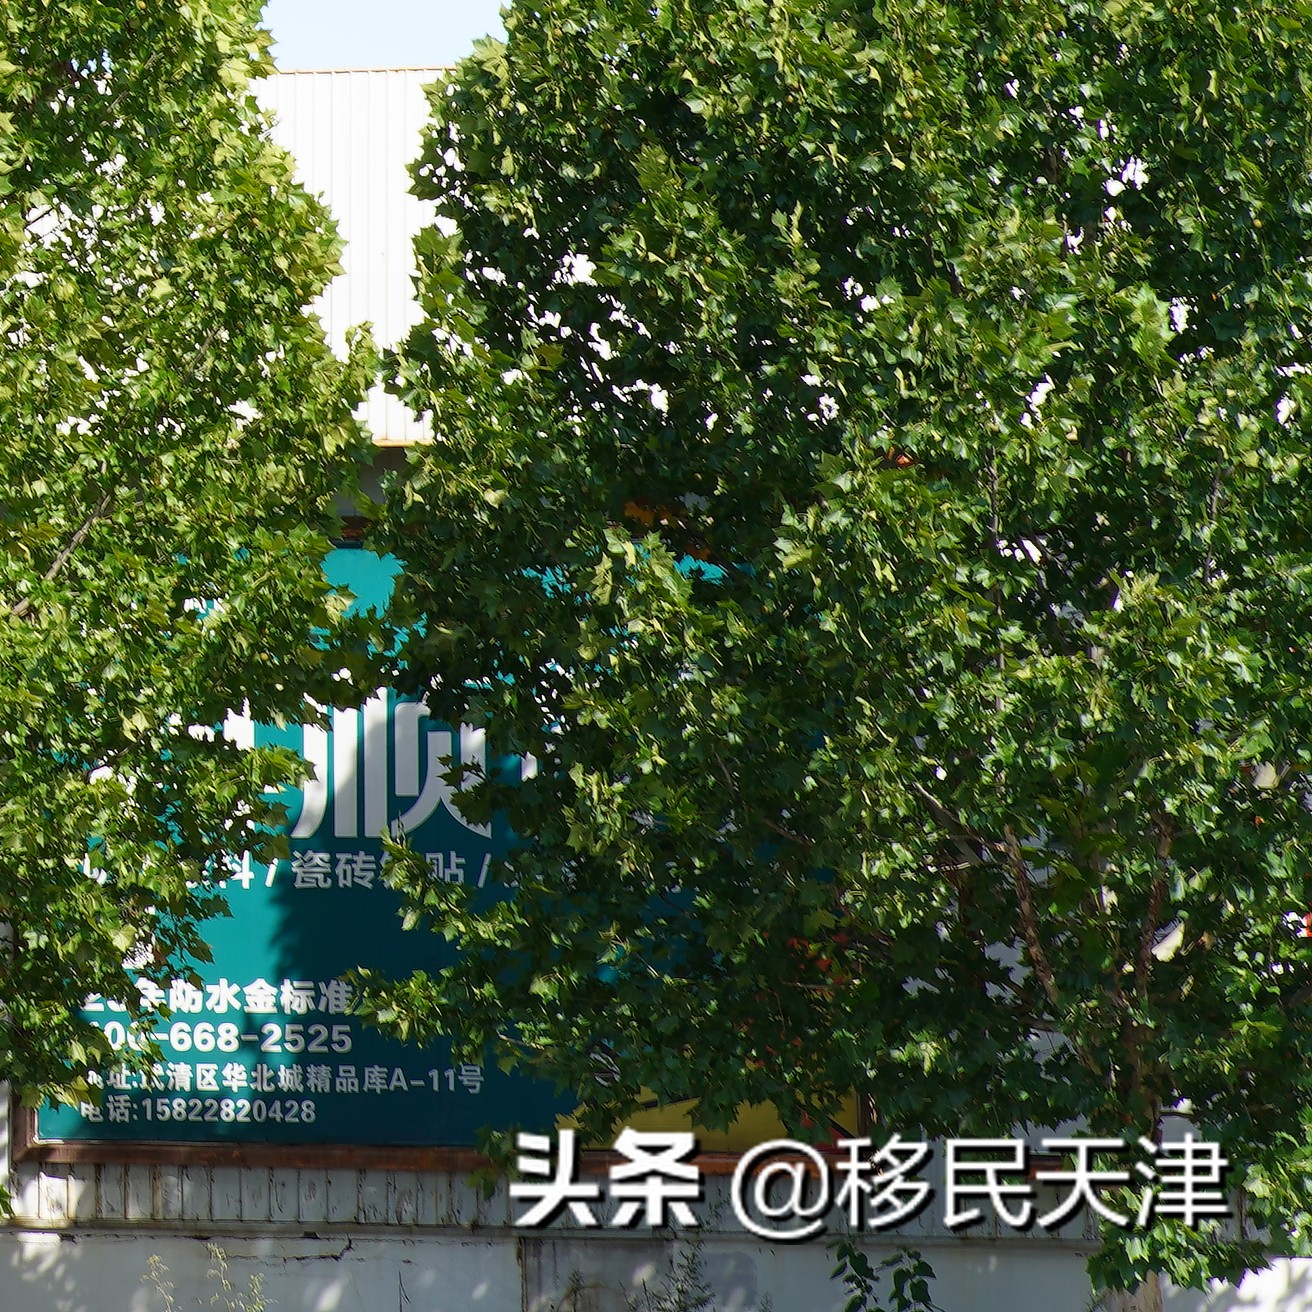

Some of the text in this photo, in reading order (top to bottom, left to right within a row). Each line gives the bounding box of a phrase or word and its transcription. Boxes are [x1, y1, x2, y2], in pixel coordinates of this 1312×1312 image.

[290, 849, 466, 890] 瓷砖贴
[89, 1020, 353, 1053] 00-668-2525
[80, 1094, 316, 1123] 电话:15822820428
